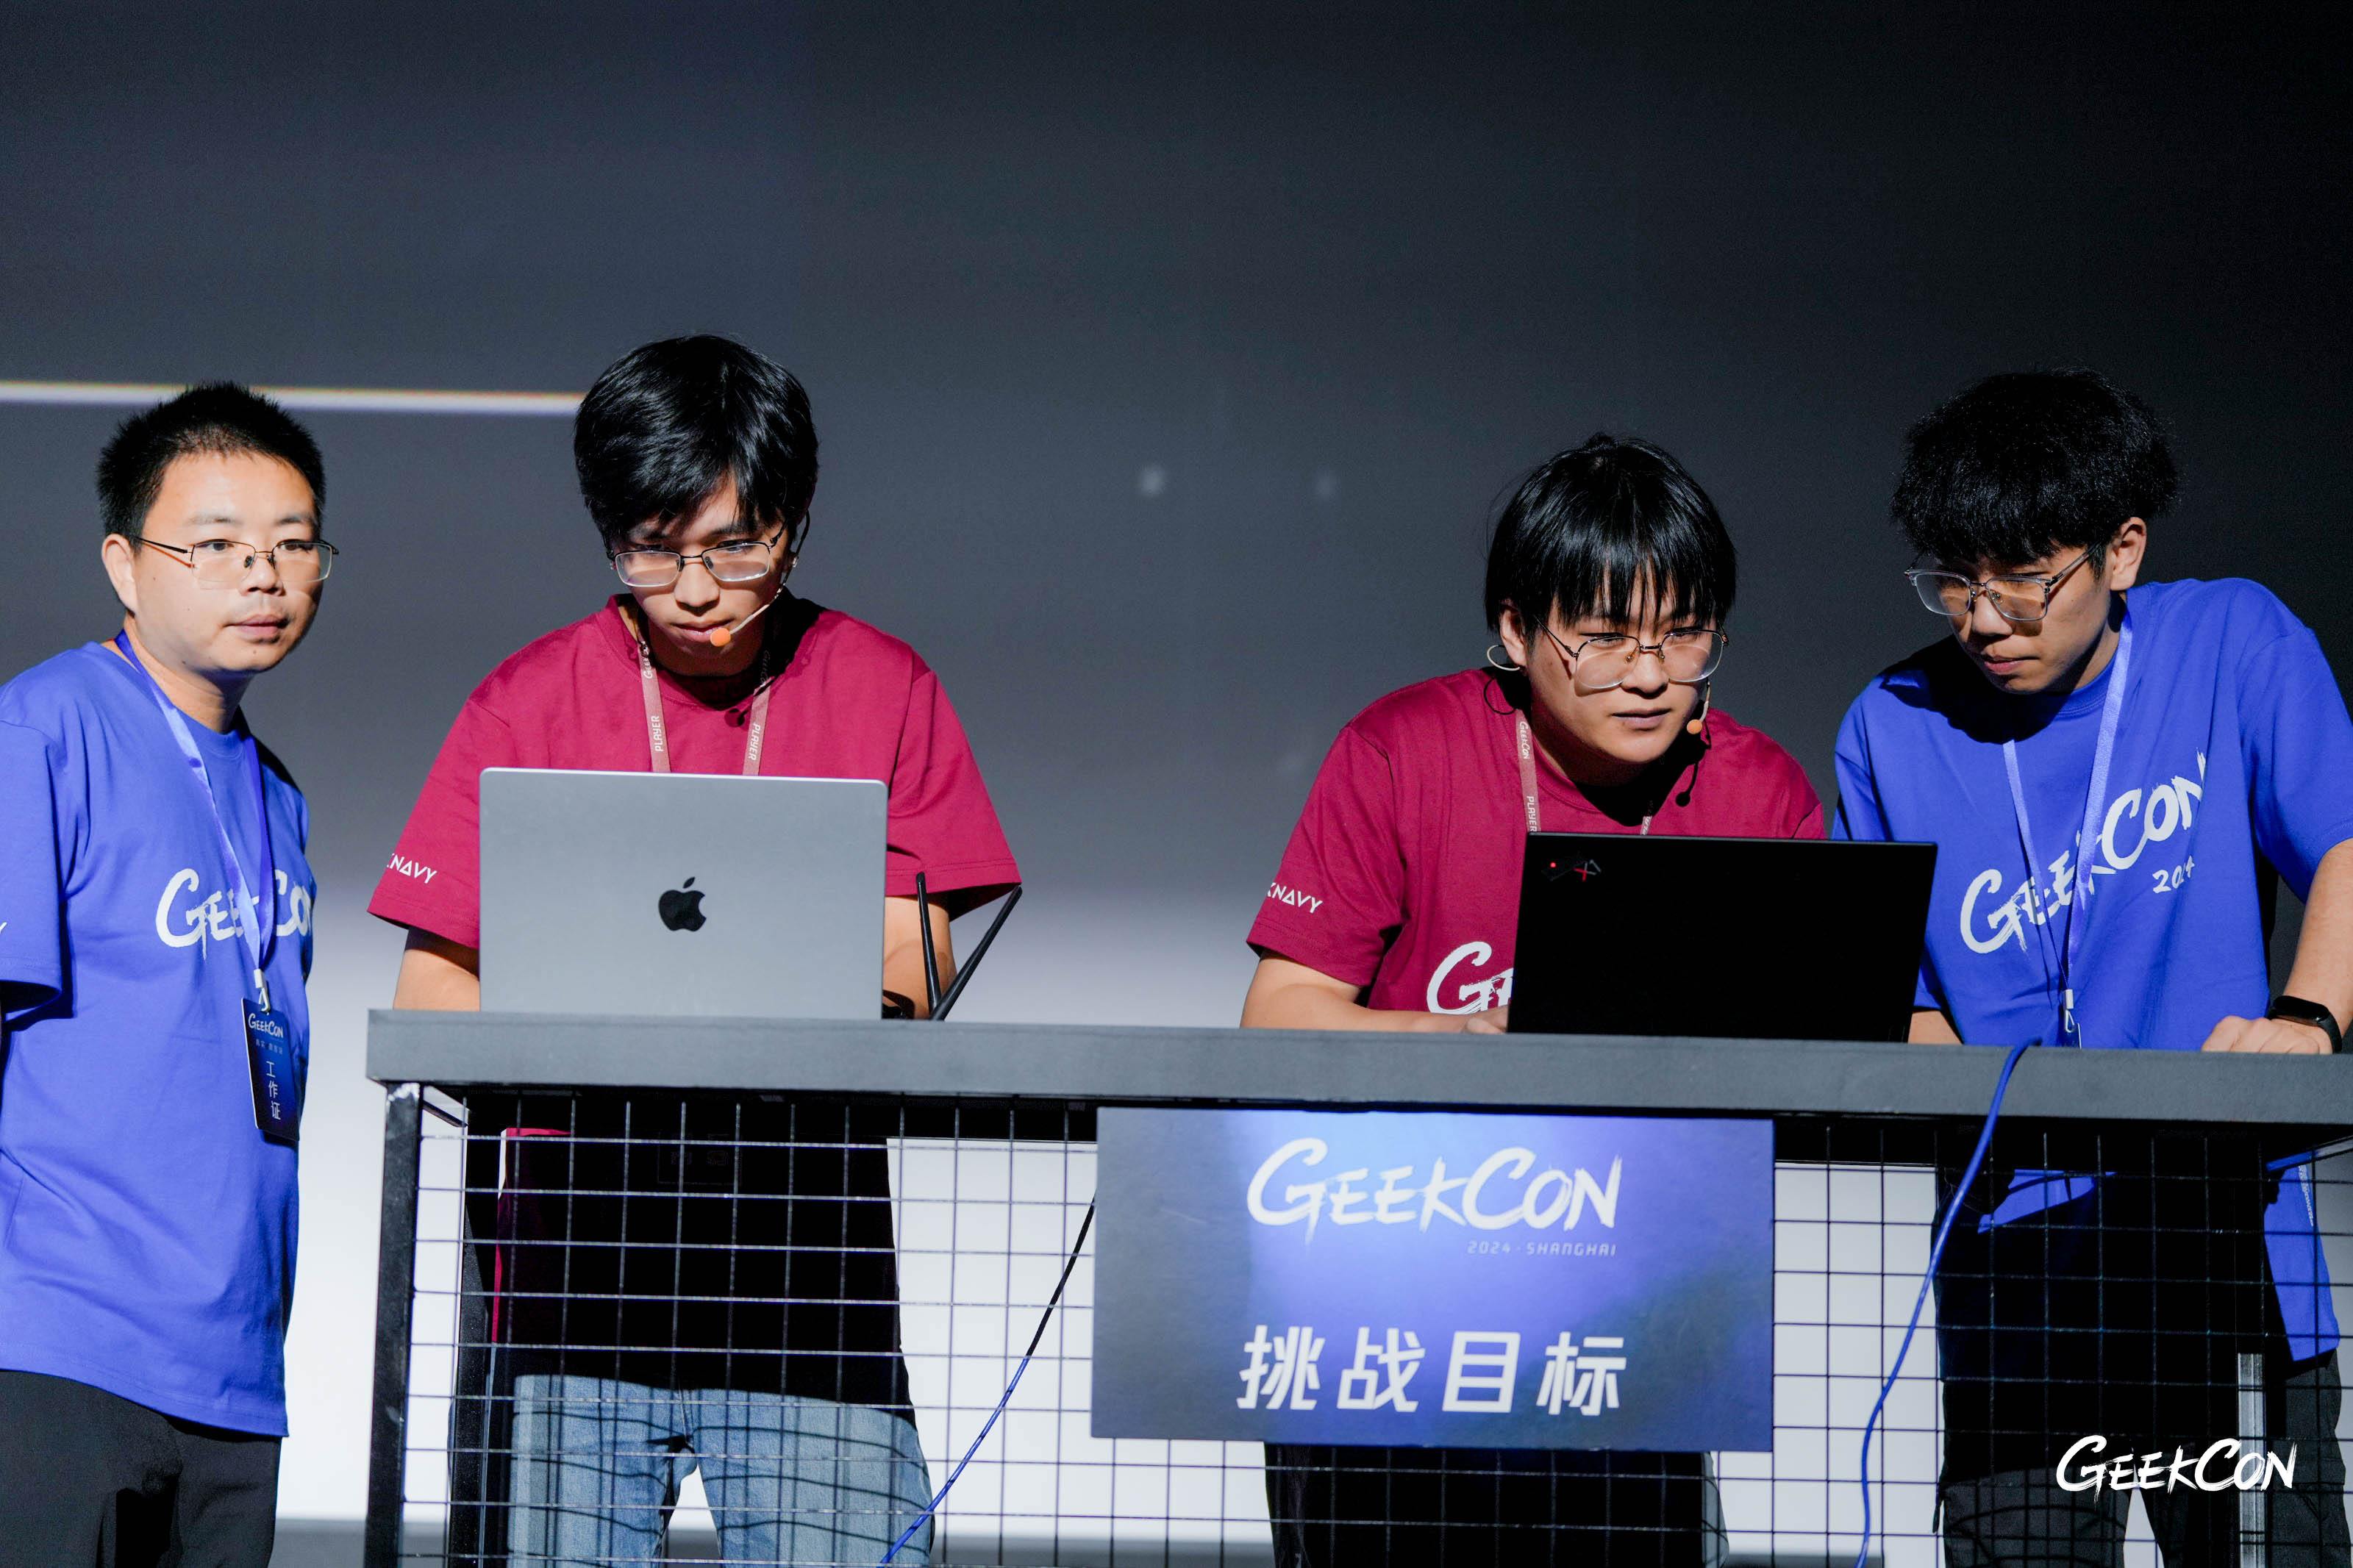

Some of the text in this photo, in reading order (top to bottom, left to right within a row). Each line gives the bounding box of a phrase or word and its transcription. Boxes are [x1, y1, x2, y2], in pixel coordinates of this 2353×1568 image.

[651, 715, 664, 752] PLAYER
[748, 723, 761, 761] PLAYER
[1527, 795, 1538, 832] PLAYER
[387, 853, 438, 884] NAVY
[265, 1061, 282, 1120] 工作证
[1467, 1240, 1617, 1257] 2024 SHANGHAI
[1236, 1324, 1627, 1416] 挑战目标
